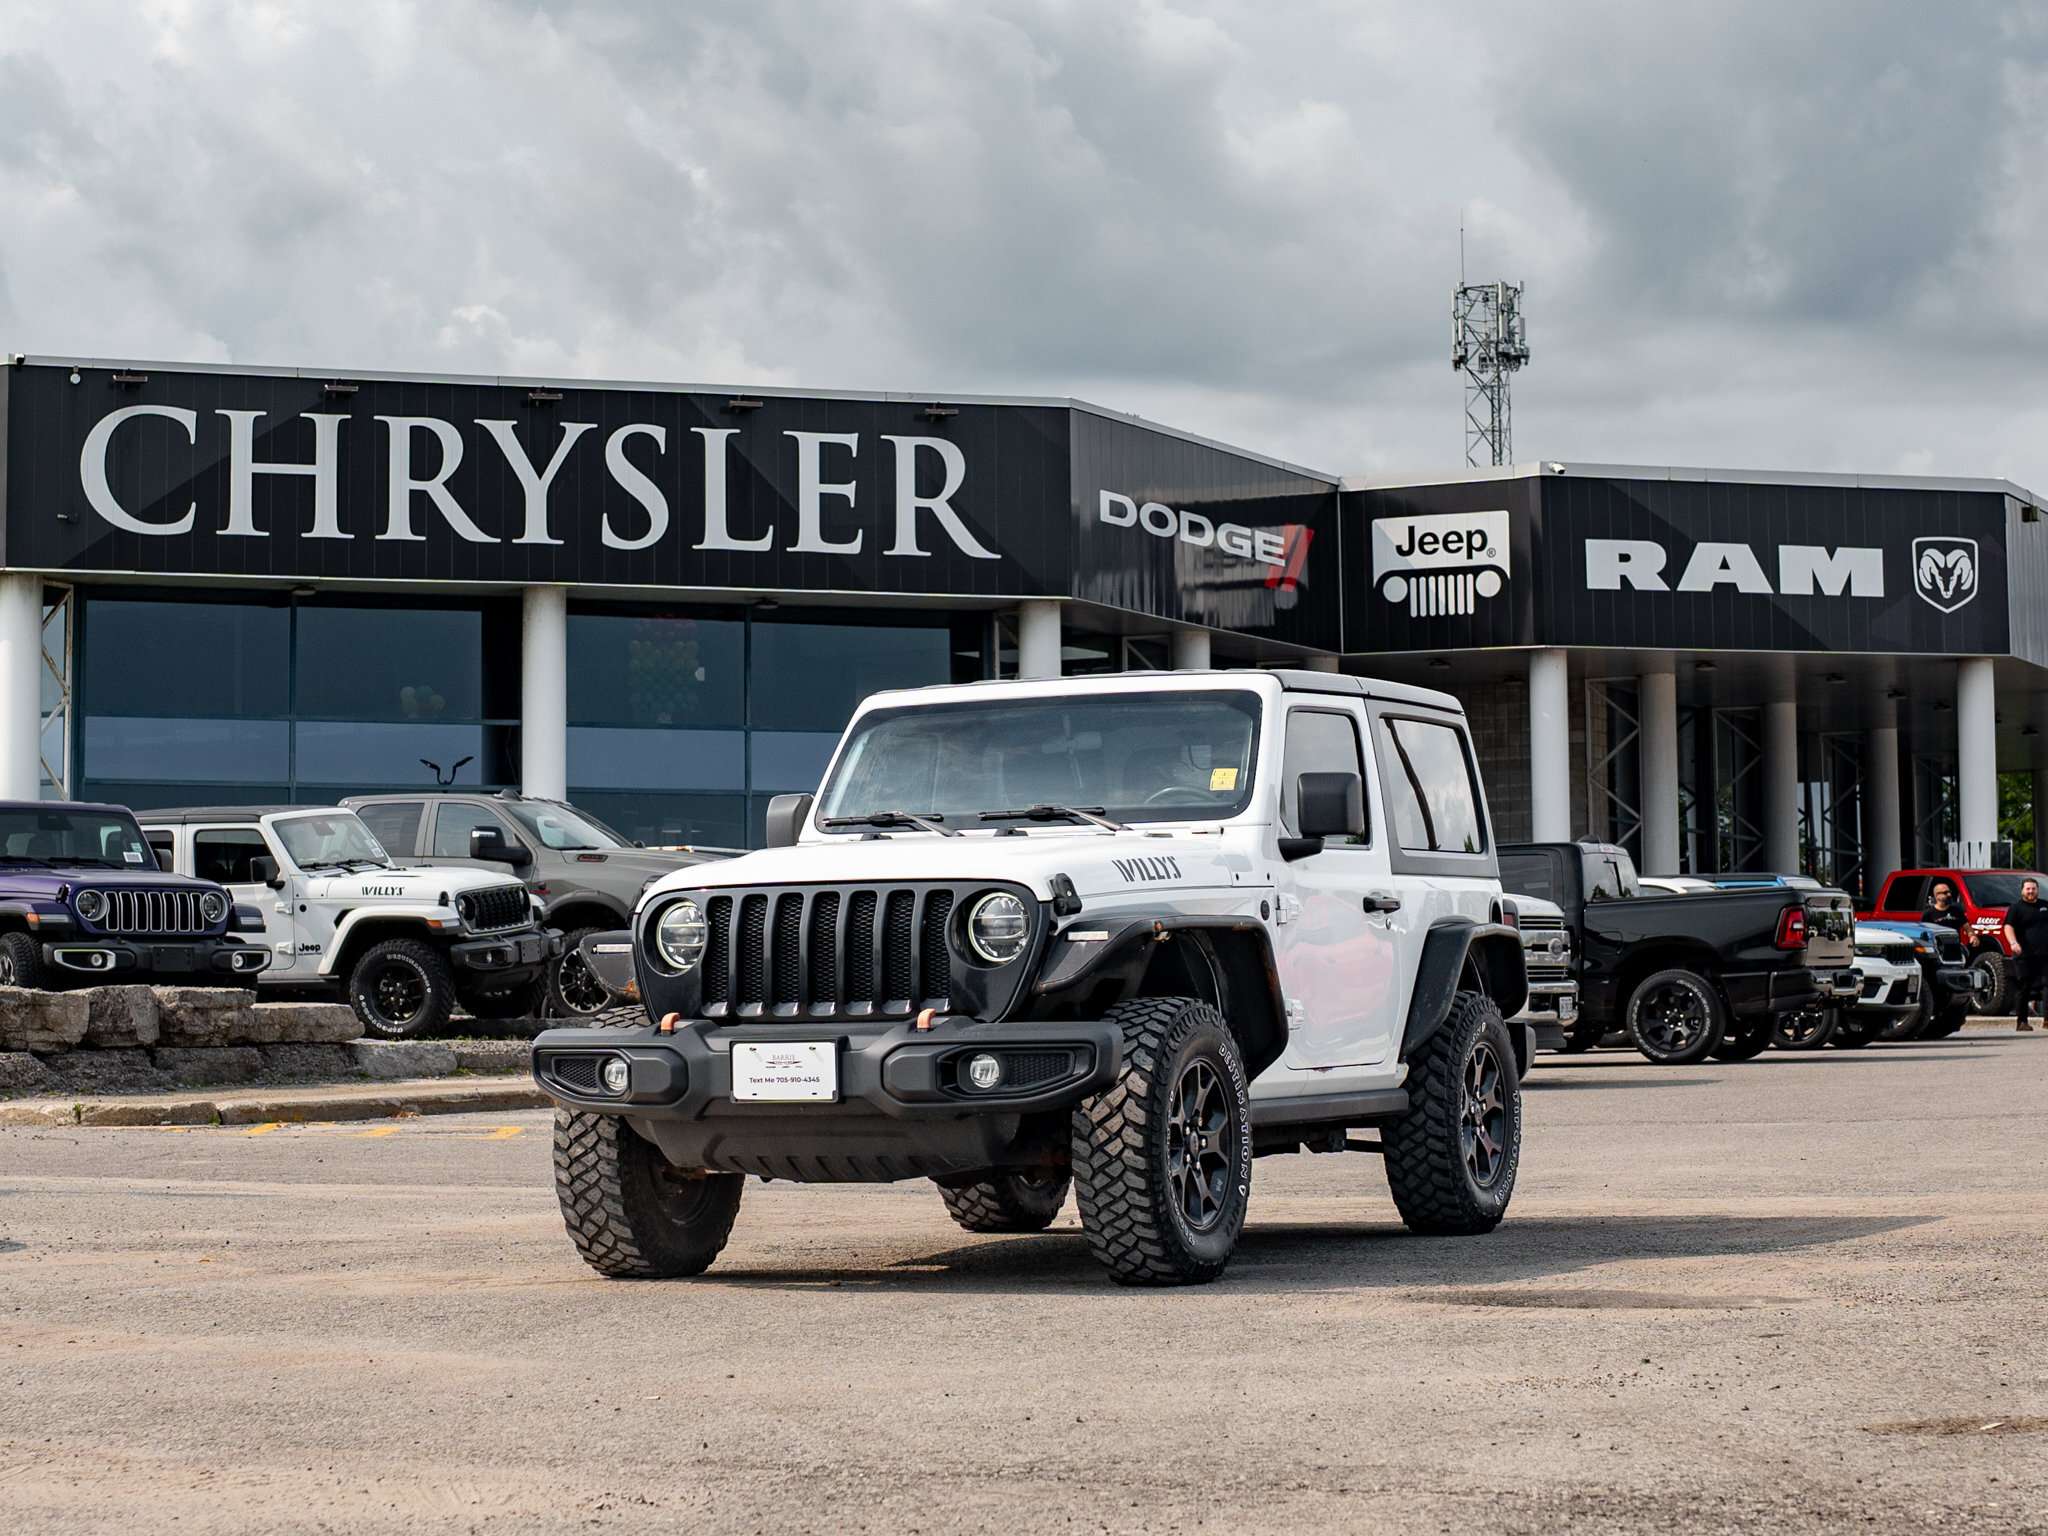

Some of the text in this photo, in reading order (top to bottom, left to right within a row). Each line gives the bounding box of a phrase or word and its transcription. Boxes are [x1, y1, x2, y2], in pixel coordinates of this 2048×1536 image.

[81, 406, 1003, 559] CHRYSLER
[1099, 489, 1286, 567] DODGE
[1395, 525, 1488, 560] Jeep
[1585, 538, 1885, 598] RAM
[1111, 856, 1182, 882] WILLYS
[1948, 841, 1991, 869] RAM
[361, 886, 405, 896] WILLYS
[298, 942, 321, 952] Jeep
[1218, 1042, 1250, 1179] DESTINATION
